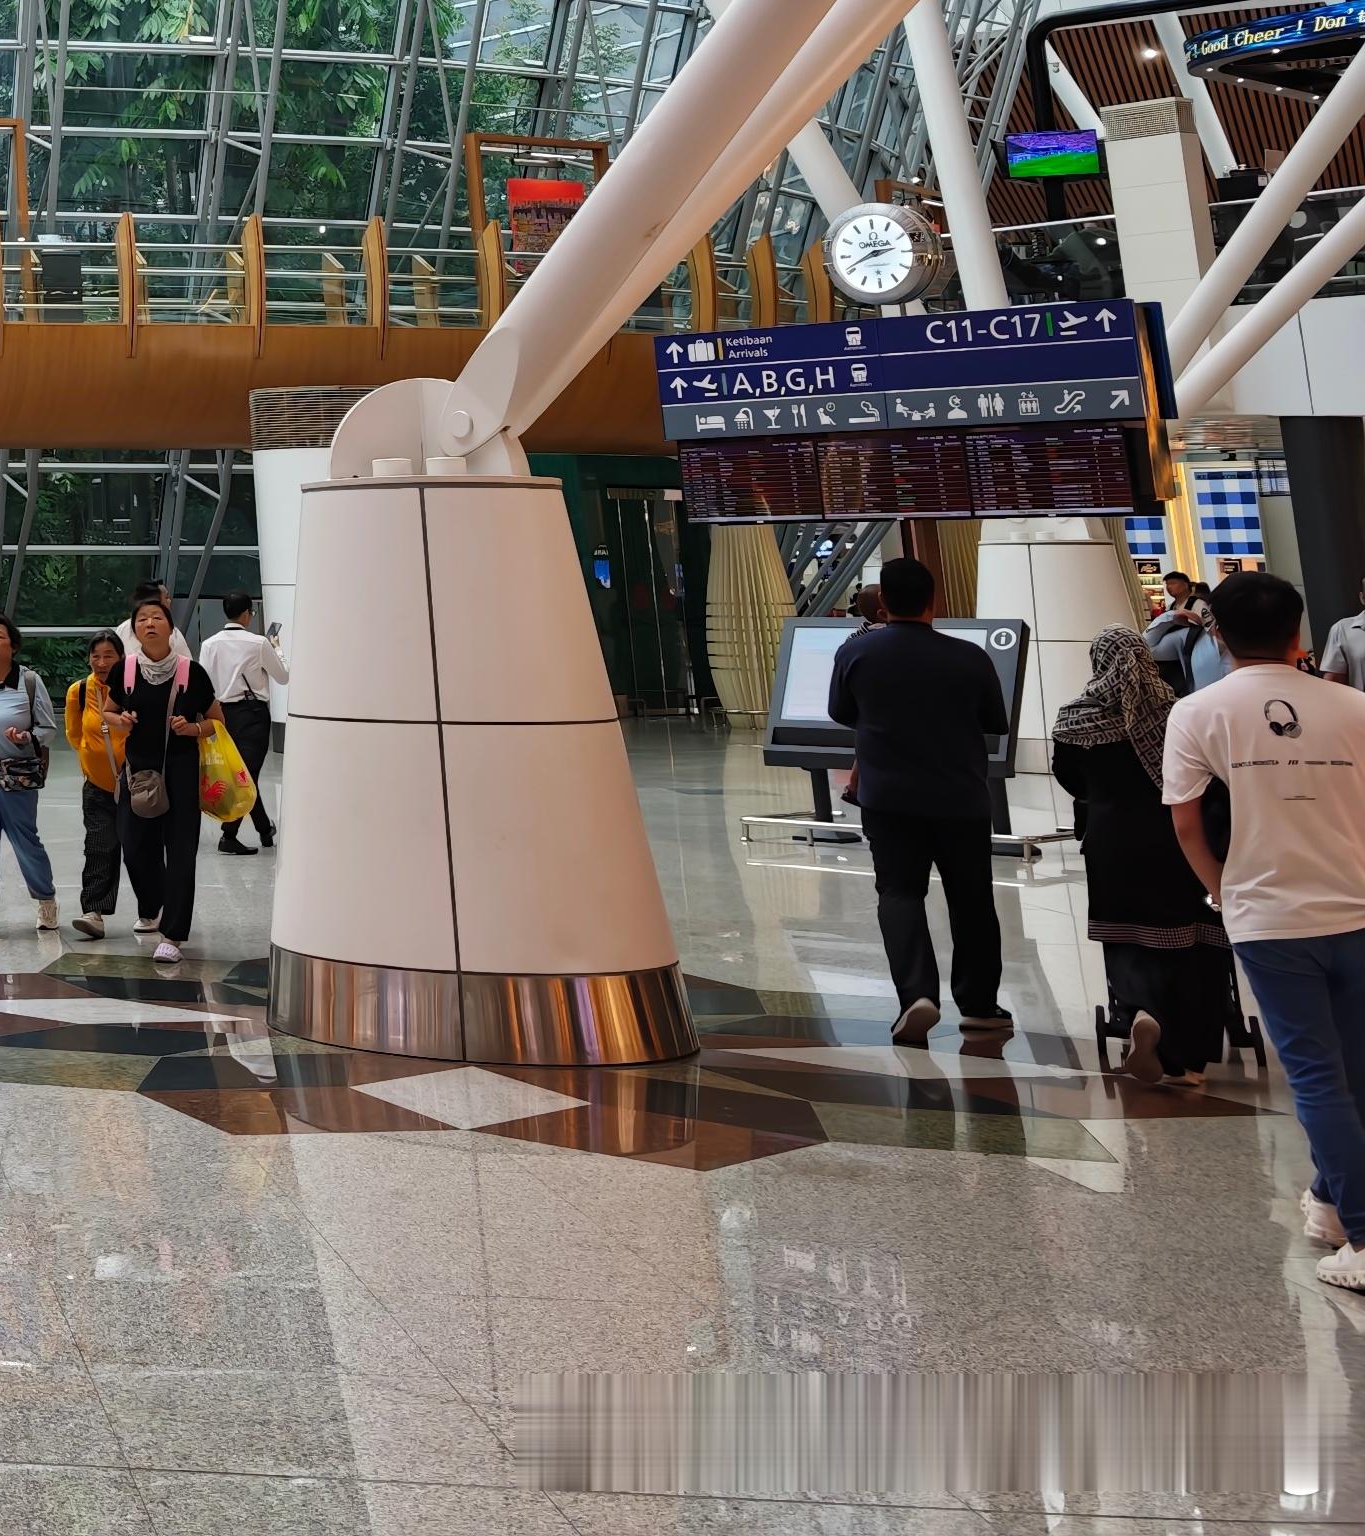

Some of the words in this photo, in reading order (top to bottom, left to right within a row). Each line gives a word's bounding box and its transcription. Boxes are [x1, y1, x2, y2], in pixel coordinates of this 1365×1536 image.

[1201, 34, 1229, 55] Good
[1235, 27, 1285, 47] Cheer
[859, 240, 891, 249] OMEGA
[926, 313, 1041, 344] C11-C17
[726, 335, 773, 346] Ketibaan
[728, 348, 769, 359] Arrivals
